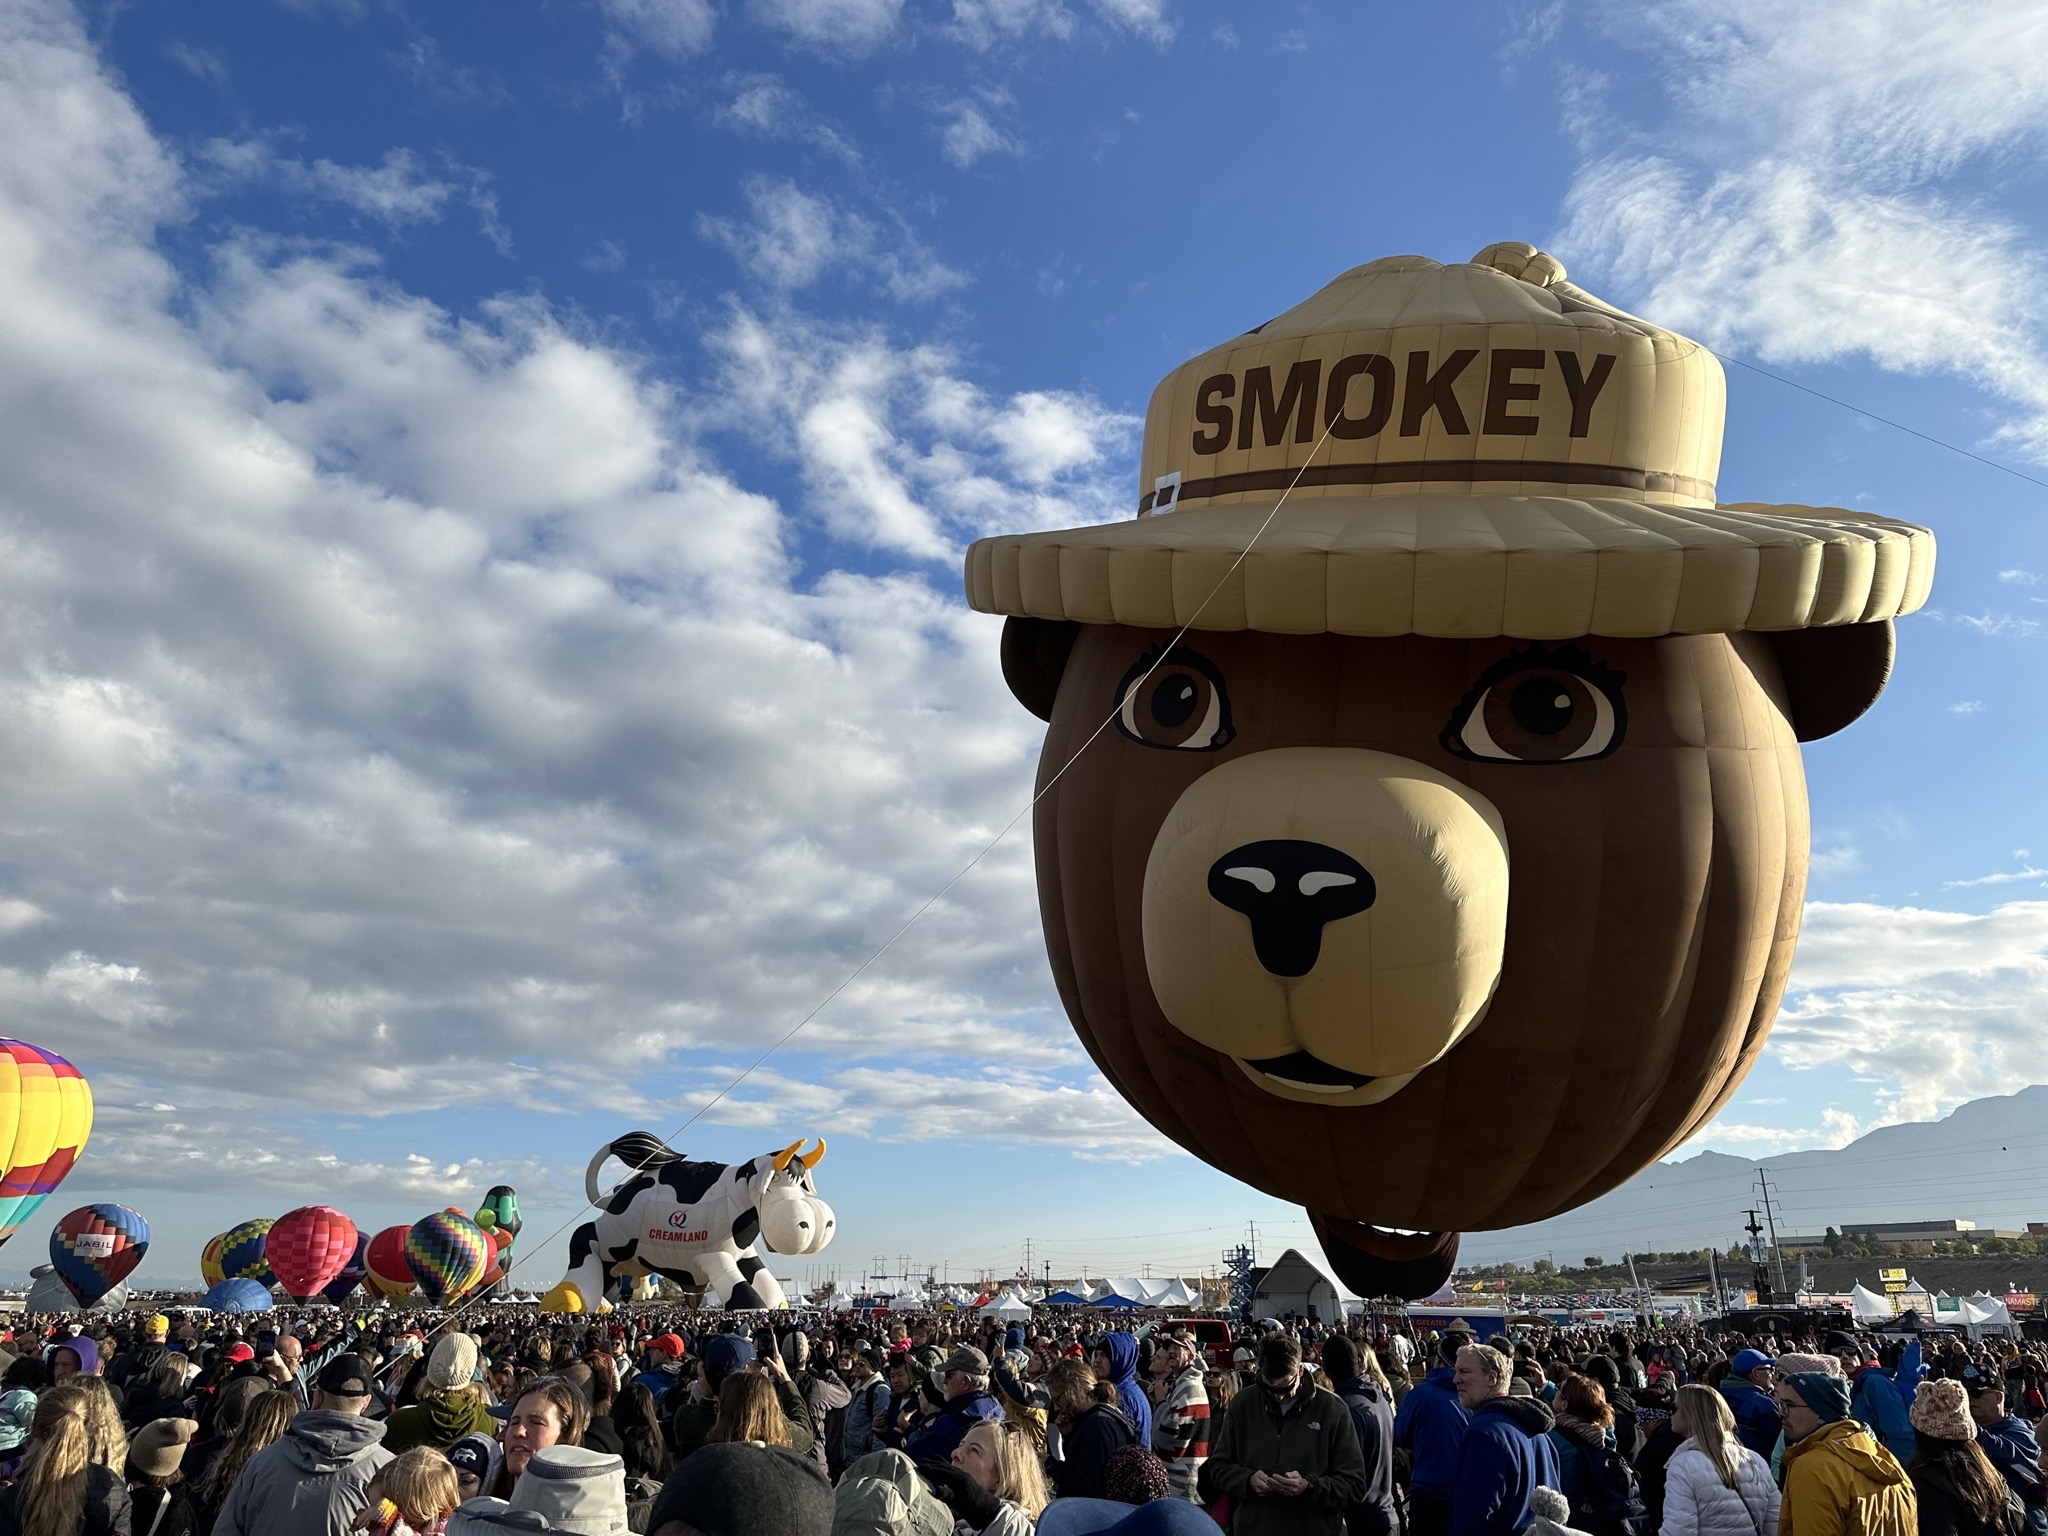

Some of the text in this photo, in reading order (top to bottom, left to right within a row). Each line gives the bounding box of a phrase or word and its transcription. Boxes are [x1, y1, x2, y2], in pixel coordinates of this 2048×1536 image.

[1192, 348, 1617, 456] SMOKEY
[649, 1229, 708, 1242] CREAMLAND
[76, 1241, 113, 1249] JABIL
[2005, 1297, 2041, 1307] NAMASTE
[1416, 1319, 1448, 1327] GREATER
